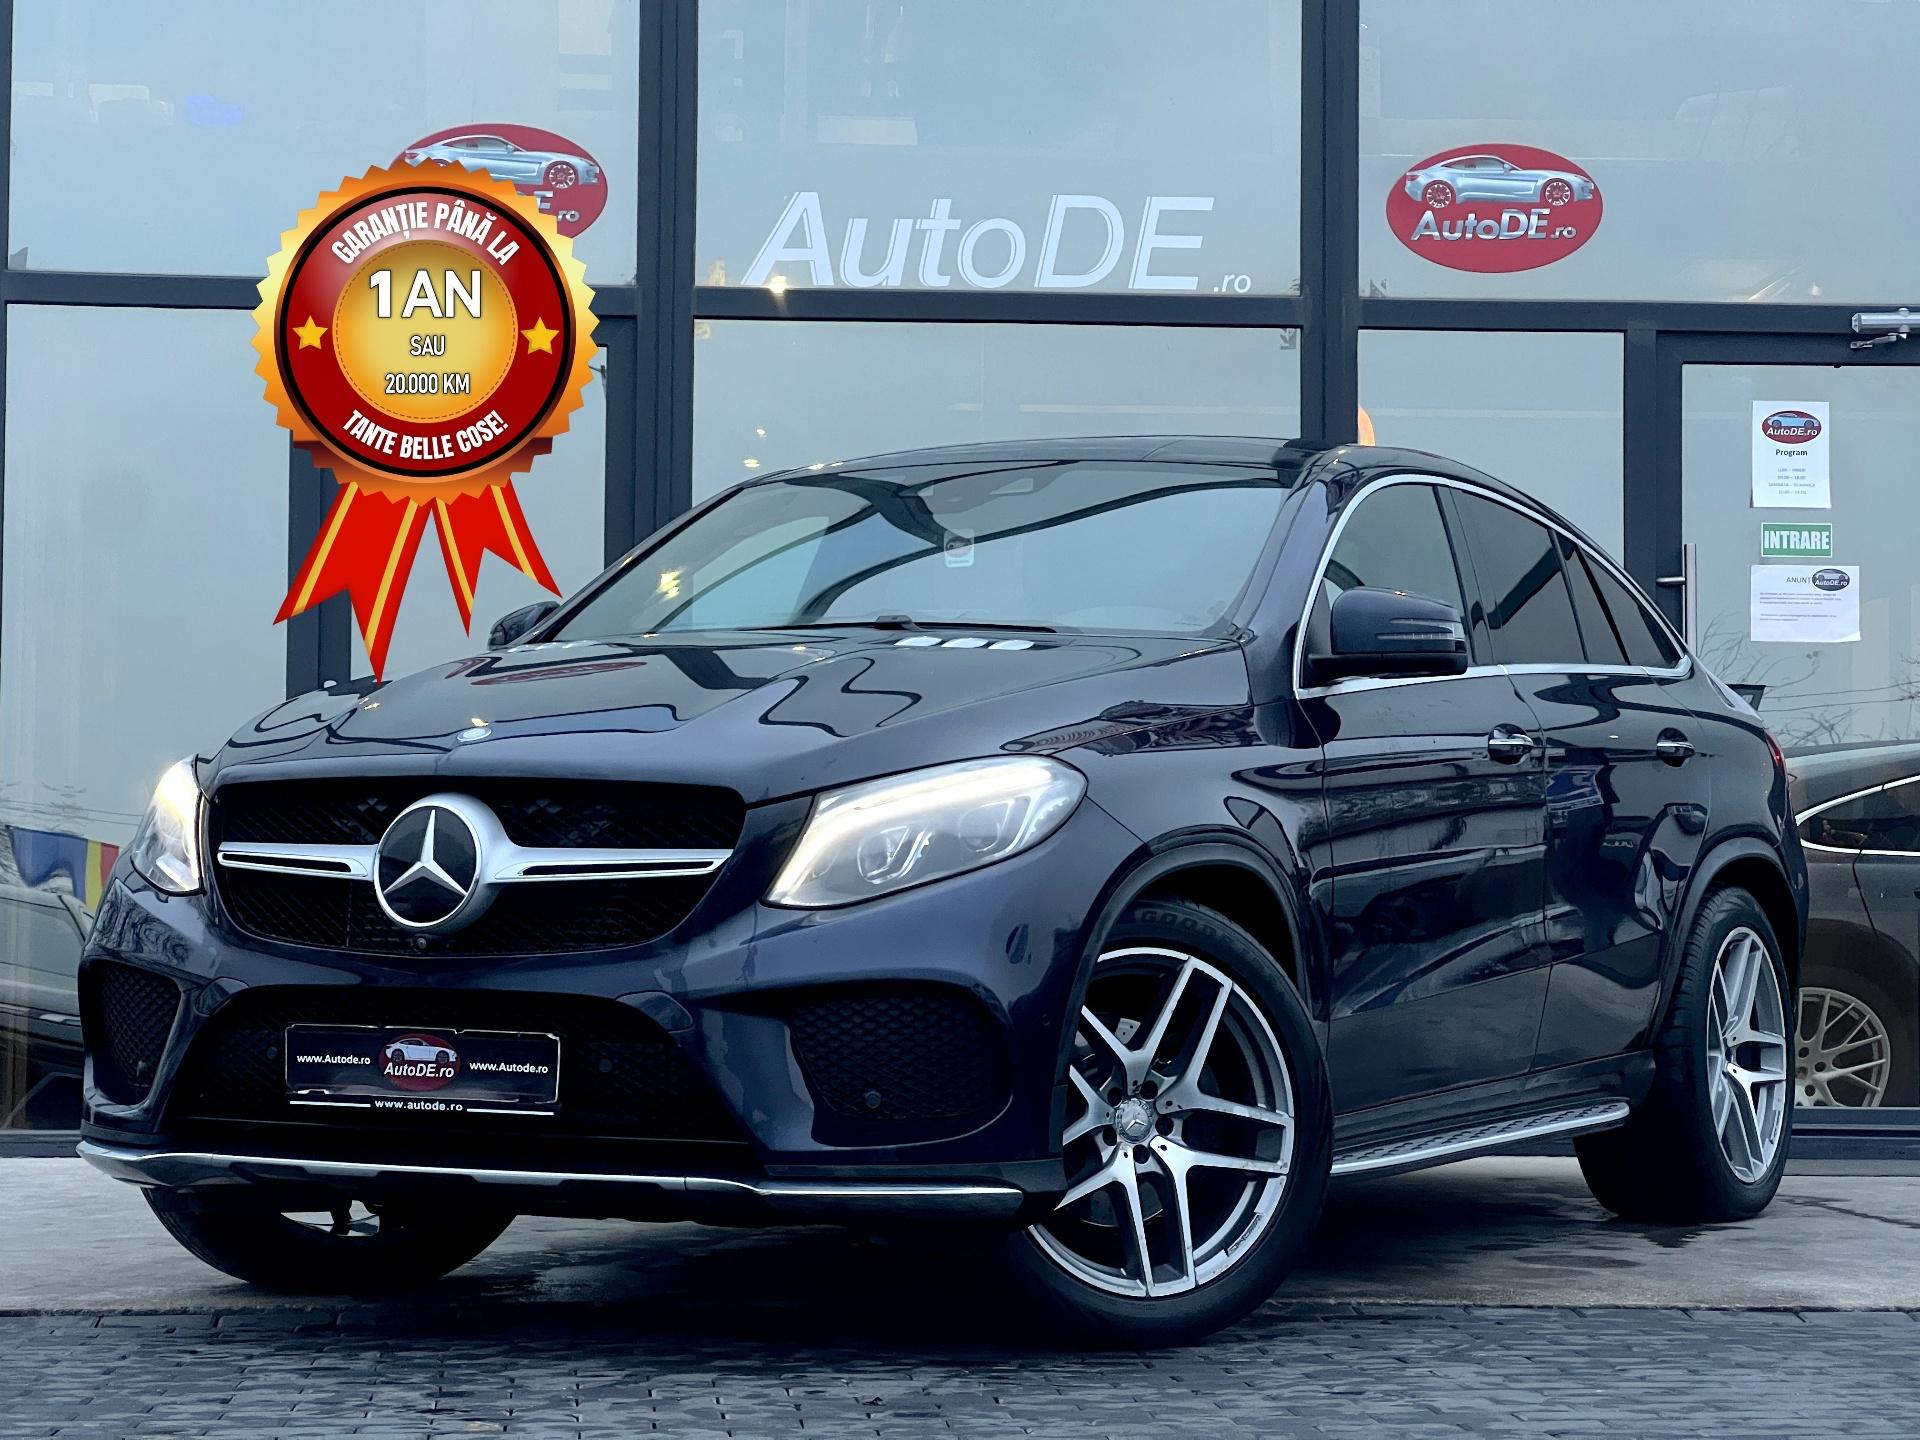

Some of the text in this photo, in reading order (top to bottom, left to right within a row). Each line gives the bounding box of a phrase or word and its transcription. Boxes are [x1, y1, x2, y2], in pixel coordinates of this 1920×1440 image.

[1766, 427, 1818, 436] AutoDE.ro
[1775, 449, 1808, 458] Program
[1763, 530, 1830, 550] INTRARE
[296, 1054, 371, 1065] www.Autode.ro
[383, 1062, 455, 1078] AutoDE.ro
[469, 1060, 549, 1074] www.Autode.ro
[374, 1099, 464, 1112] www.autode.ro
